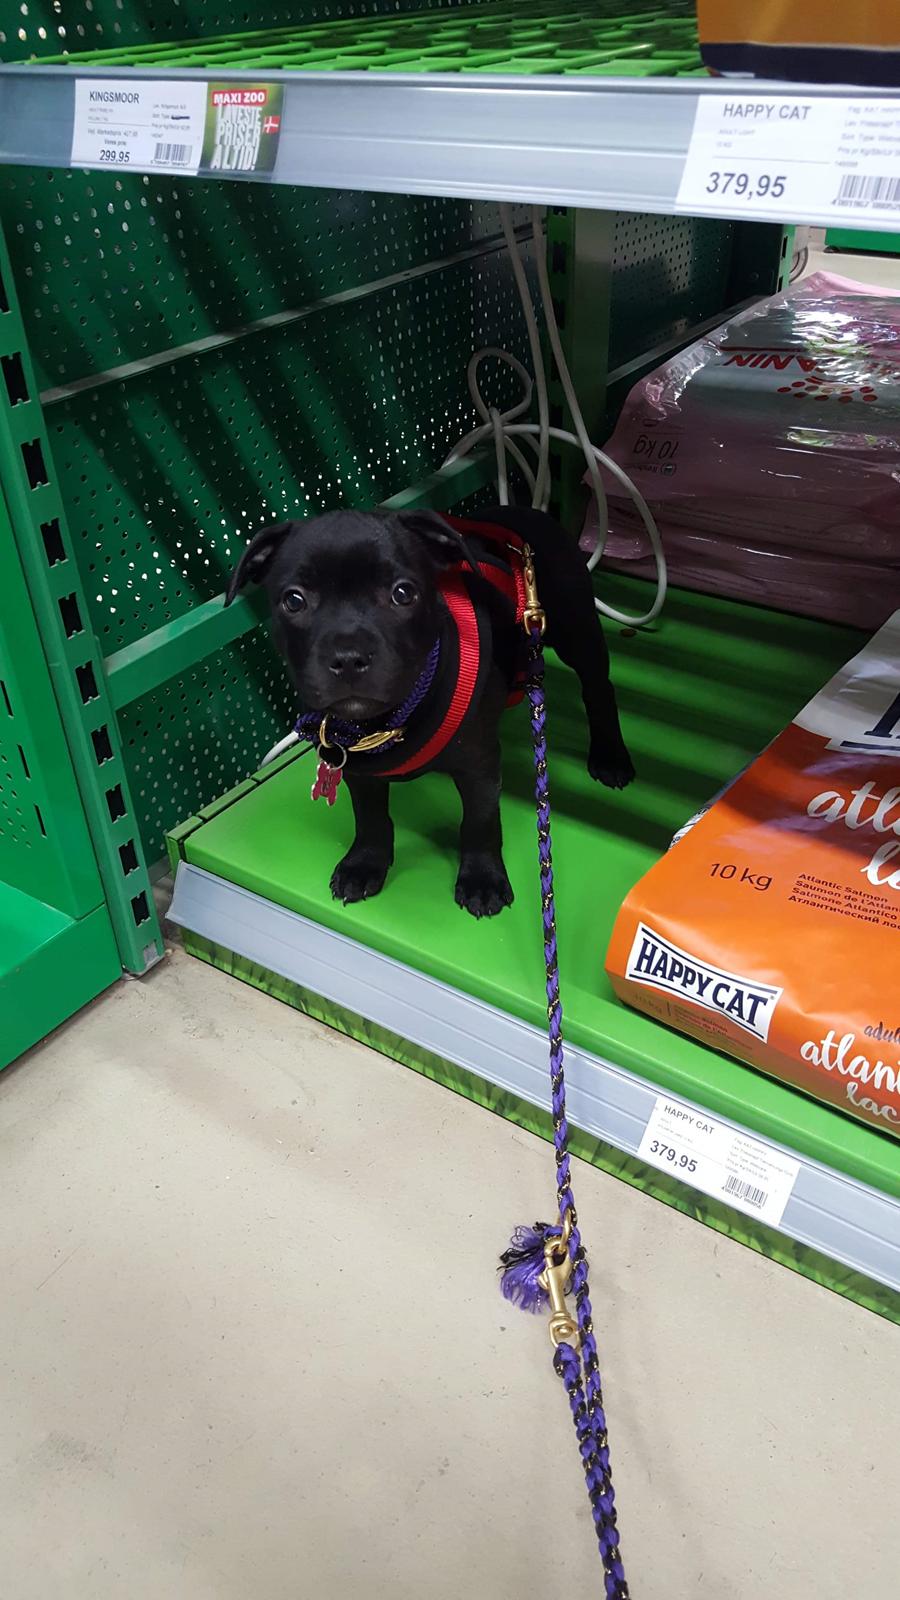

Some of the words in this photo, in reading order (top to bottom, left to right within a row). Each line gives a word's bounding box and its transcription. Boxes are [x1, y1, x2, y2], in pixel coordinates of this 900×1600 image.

[89, 91, 140, 105] KINGSMOOR
[213, 92, 241, 104] MAXI
[243, 91, 265, 103] ZOO
[723, 103, 775, 119] HAPPY
[778, 105, 812, 120] CAT
[216, 120, 261, 148] PRISER
[706, 171, 787, 200] 379,95
[633, 435, 657, 459] kg
[657, 441, 679, 459] 10
[709, 863, 737, 880] 10
[740, 867, 773, 891] kg
[798, 873, 843, 891] Atlantic
[844, 886, 888, 903] Salmon
[788, 895, 880, 924] Атлантический
[792, 887, 842, 905] Salmone
[844, 903, 898, 920] Atlantico
[795, 880, 841, 898] Saumon
[844, 894, 858, 902] de
[861, 898, 900, 914] l'Atlan
[634, 937, 713, 998] HAPPY
[712, 983, 768, 1027] CAT
[800, 1030, 900, 1095] atlan
[663, 1105, 695, 1125] HAPPY
[695, 1121, 716, 1135] CAT
[650, 1140, 698, 1173] 379,95
